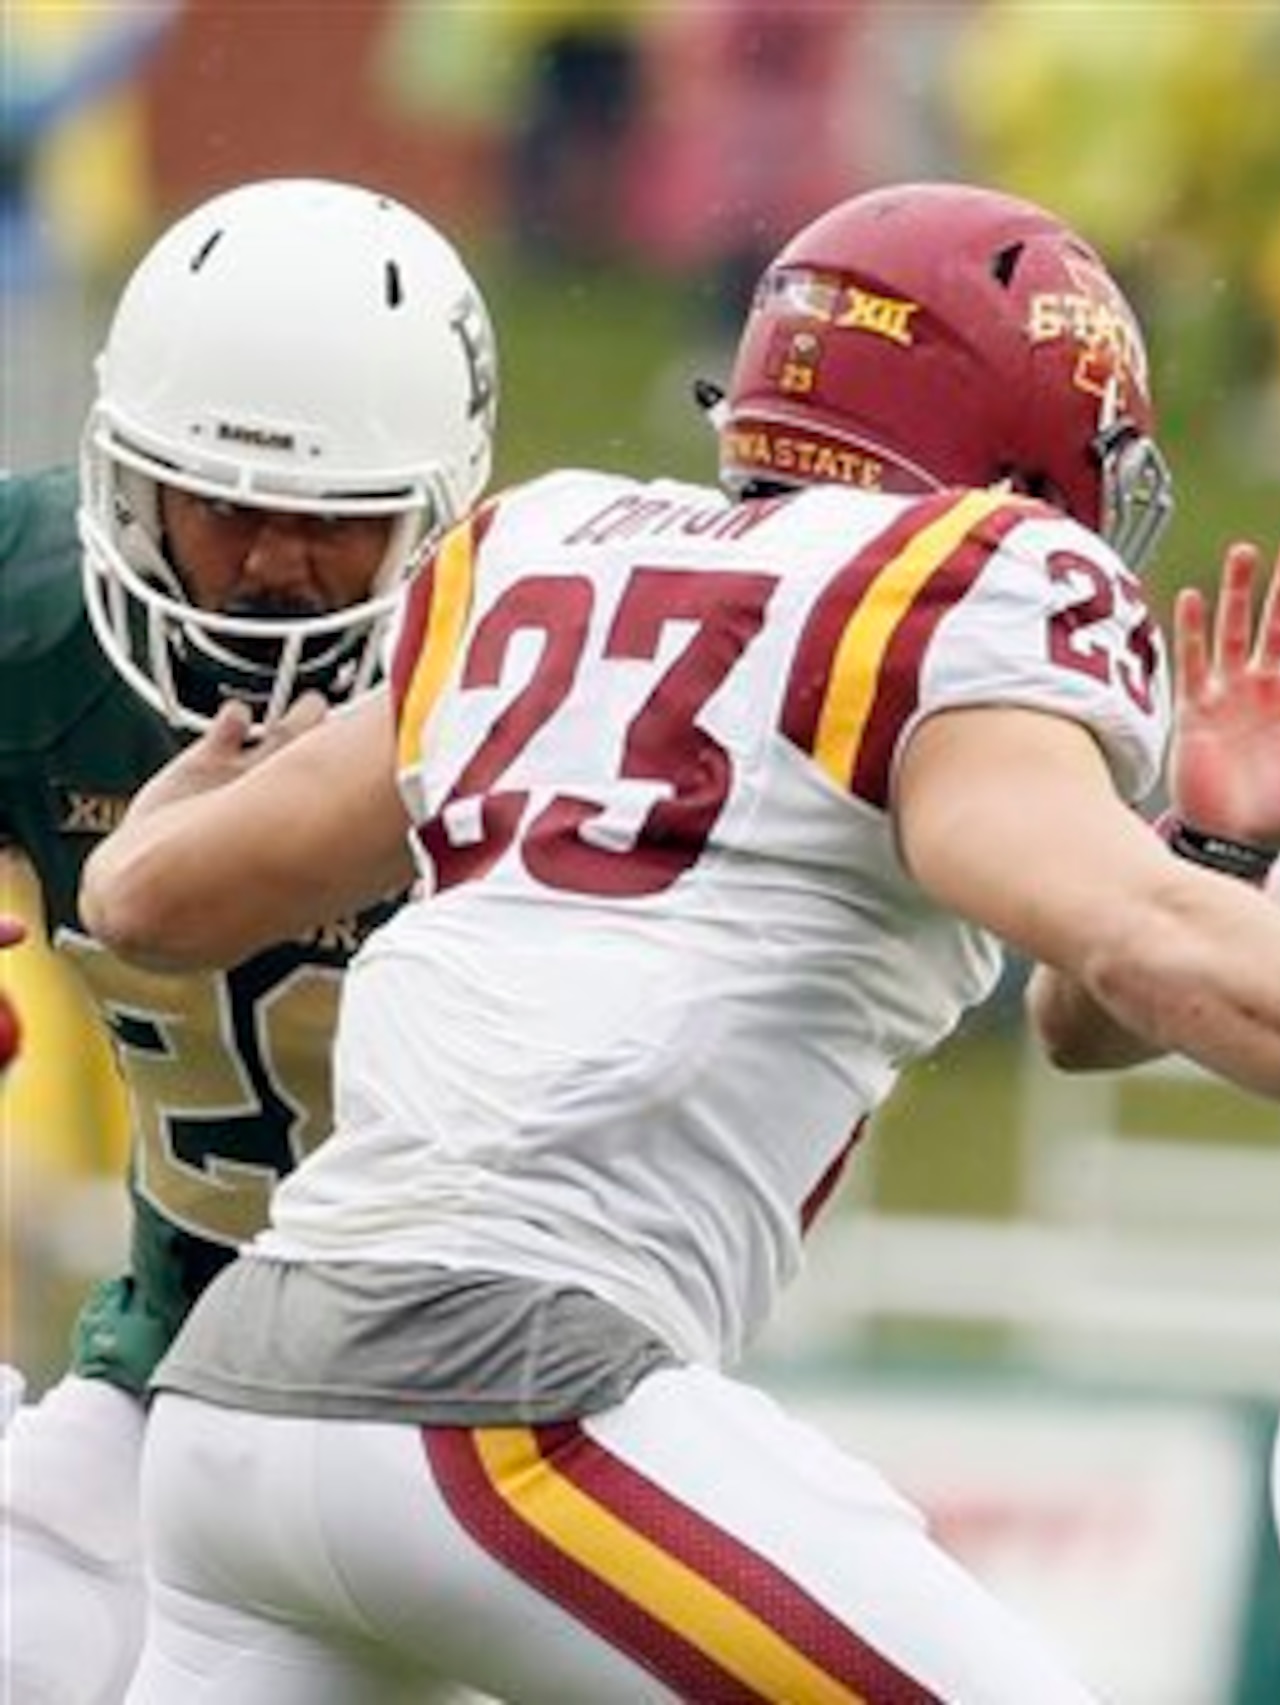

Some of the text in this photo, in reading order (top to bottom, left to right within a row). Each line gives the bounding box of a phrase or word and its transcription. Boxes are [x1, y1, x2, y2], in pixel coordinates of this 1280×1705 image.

[773, 436, 883, 491] STATE
[1045, 551, 1160, 716] 23
[415, 566, 780, 898] 23
